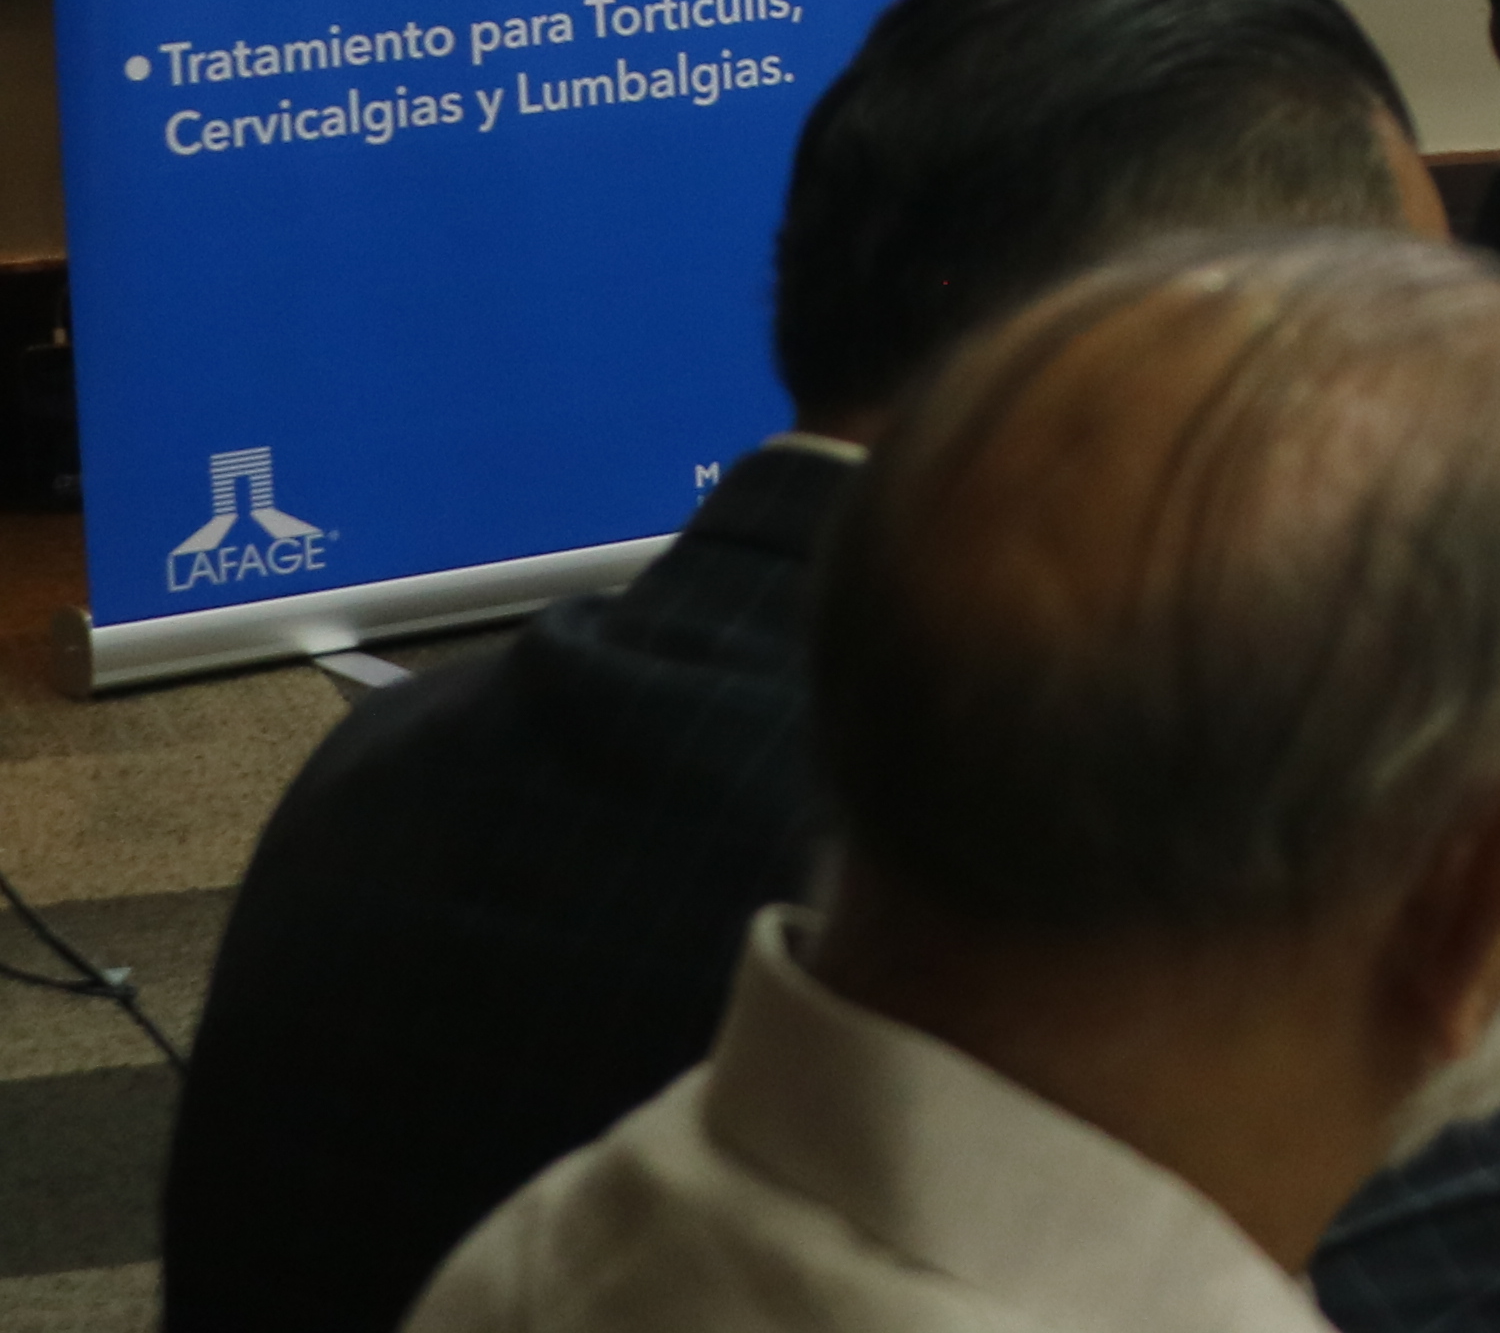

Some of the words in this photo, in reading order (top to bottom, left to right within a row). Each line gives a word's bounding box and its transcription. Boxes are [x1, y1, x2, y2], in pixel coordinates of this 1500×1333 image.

[160, 19, 455, 88] Tratamiento
[469, 12, 574, 67] para
[165, 86, 463, 156] Cervicalgias
[478, 87, 504, 132] y
[517, 50, 795, 116] Lumbalgias.
[166, 534, 326, 593] LAFAGE
